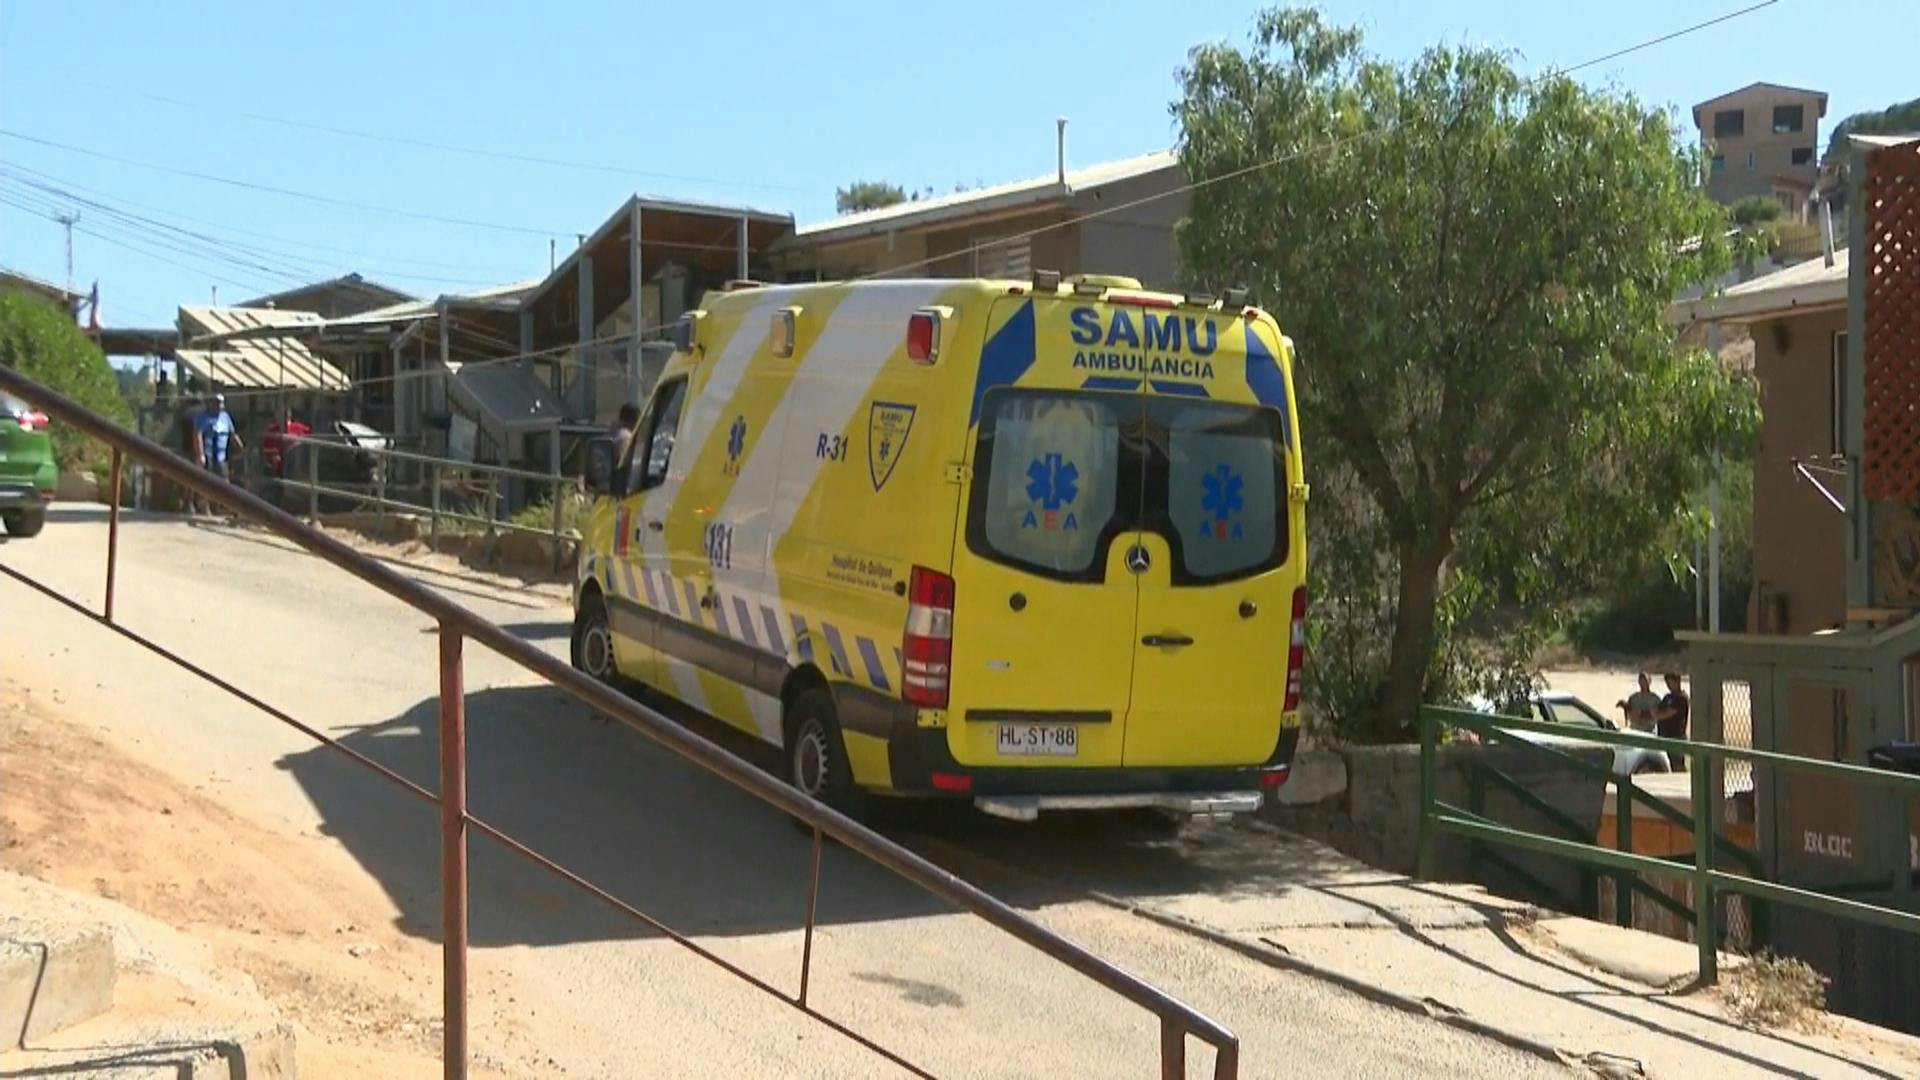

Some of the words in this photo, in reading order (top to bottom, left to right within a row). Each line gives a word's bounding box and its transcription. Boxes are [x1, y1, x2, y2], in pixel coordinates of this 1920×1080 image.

[1070, 307, 1218, 357] SAMU
[1073, 350, 1215, 379] AMBULANCIA
[816, 432, 849, 462] R-31
[709, 522, 733, 571] 131
